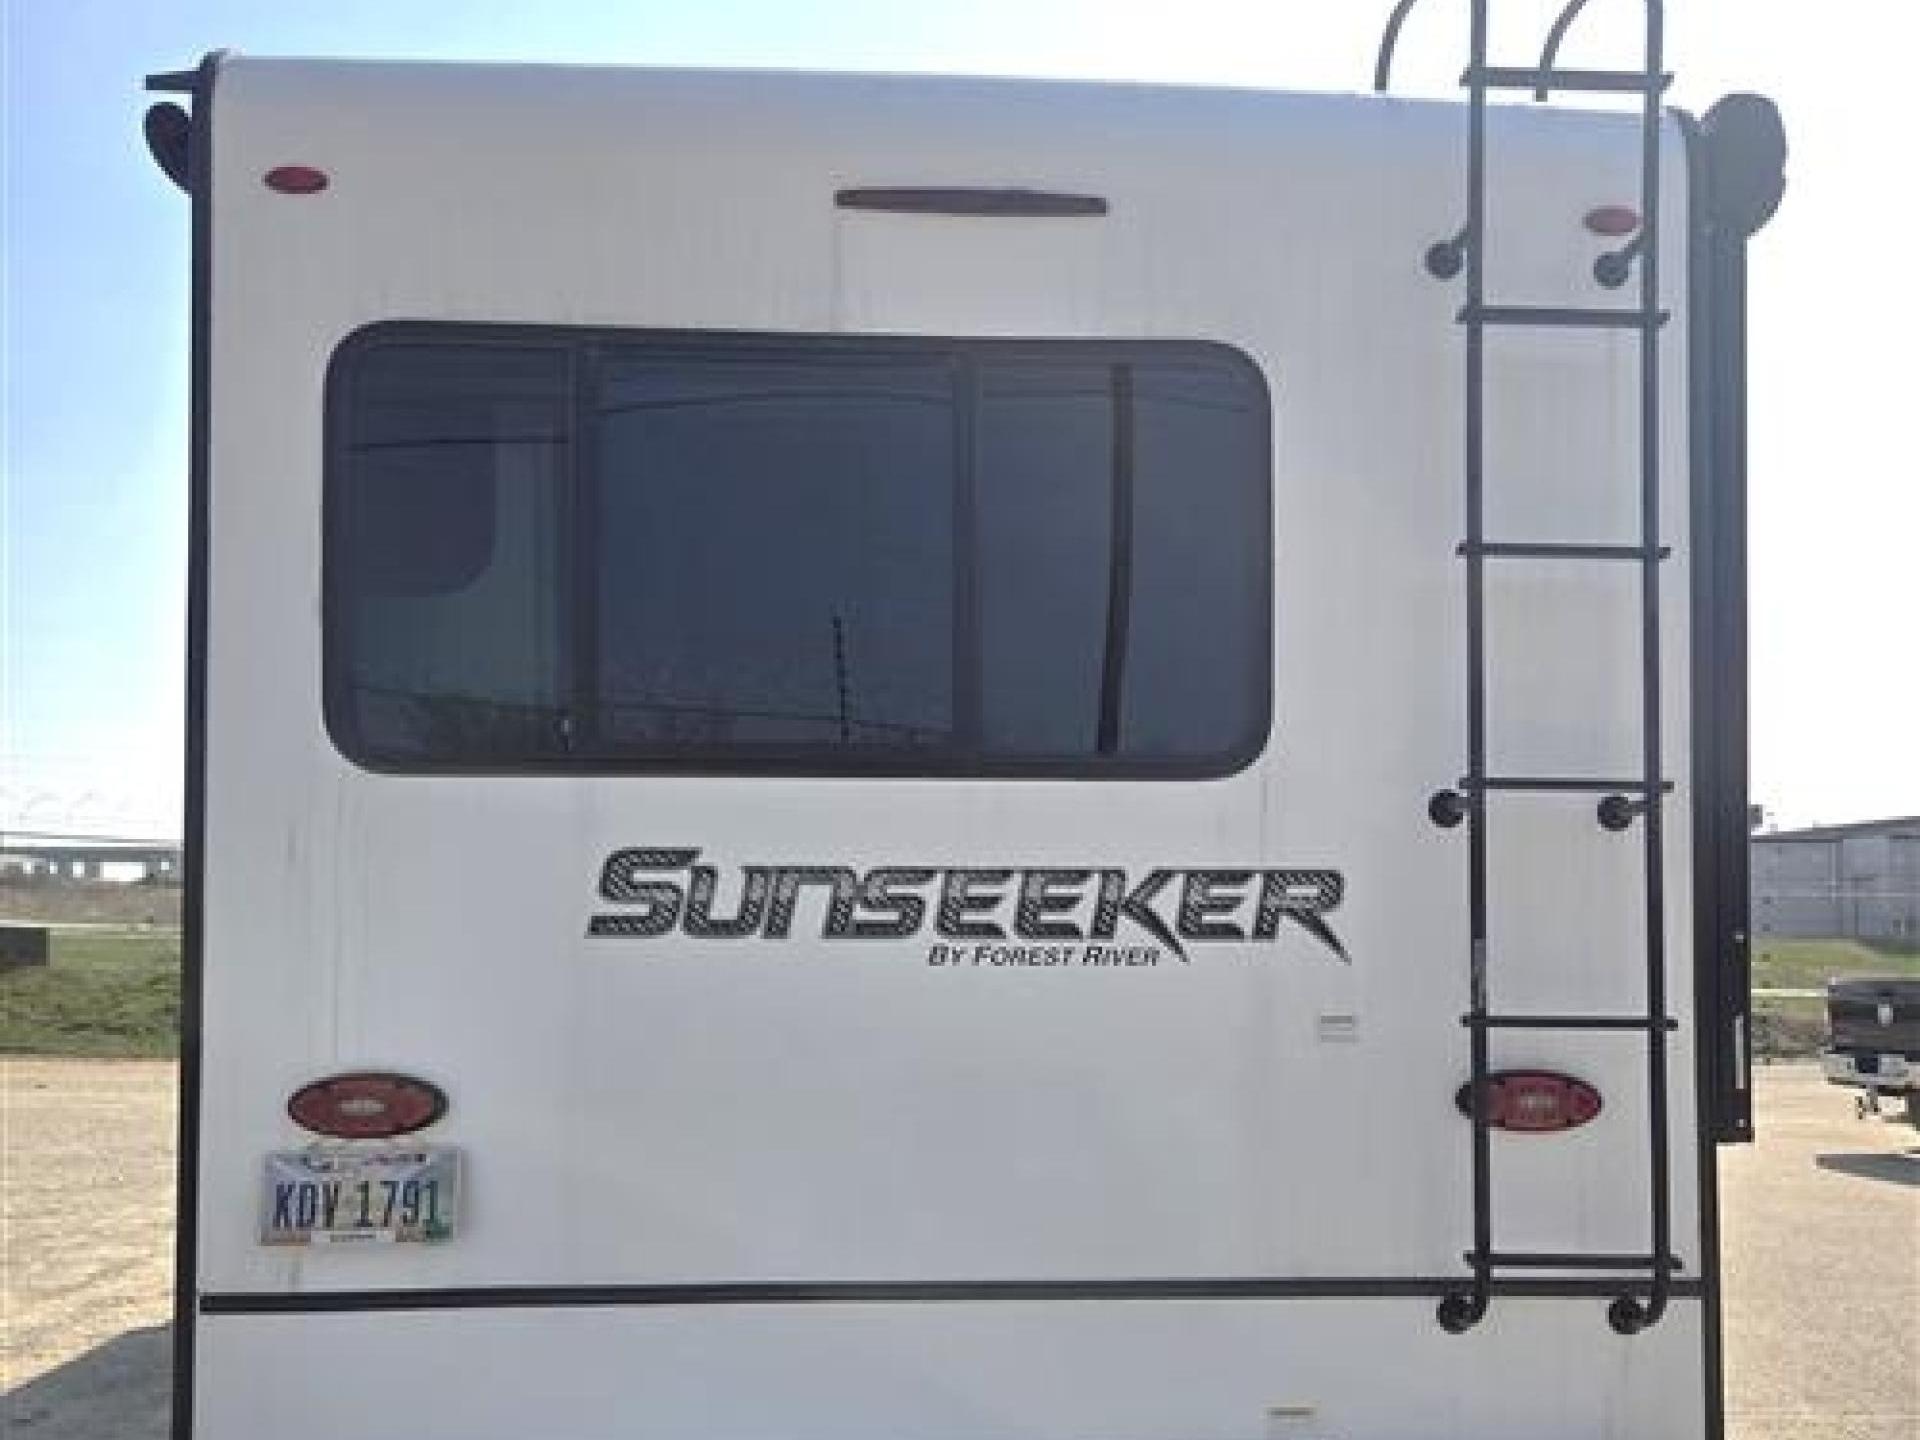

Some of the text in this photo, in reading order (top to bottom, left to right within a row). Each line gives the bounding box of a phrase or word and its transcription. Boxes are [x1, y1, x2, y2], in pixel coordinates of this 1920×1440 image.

[928, 943, 1161, 967] BY FOREST RIVER
[354, 1180, 440, 1229] 1791
